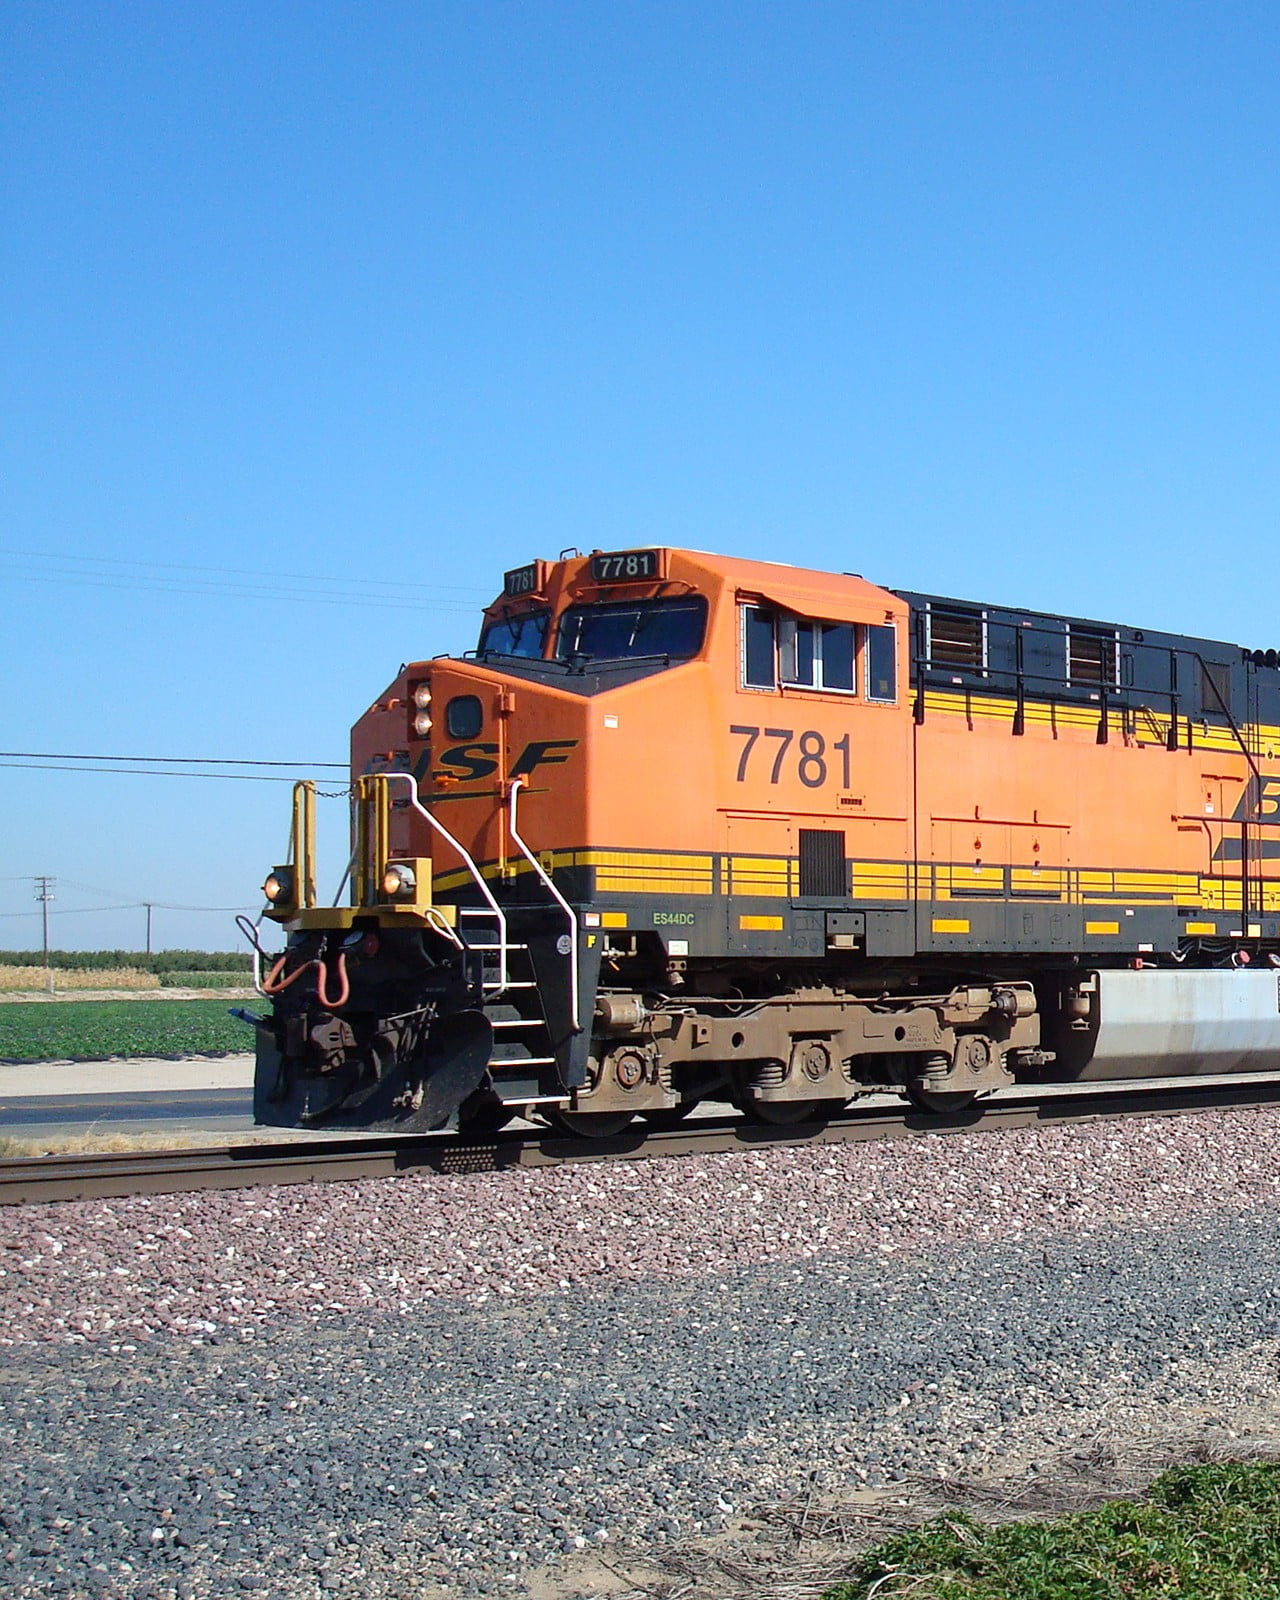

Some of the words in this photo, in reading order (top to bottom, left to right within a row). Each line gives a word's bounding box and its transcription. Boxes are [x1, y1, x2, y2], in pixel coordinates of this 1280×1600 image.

[601, 555, 649, 578] 7781
[509, 569, 534, 594] 7781
[730, 725, 850, 789] 7781
[653, 912, 695, 925] ES44DC
[586, 934, 597, 949] F
